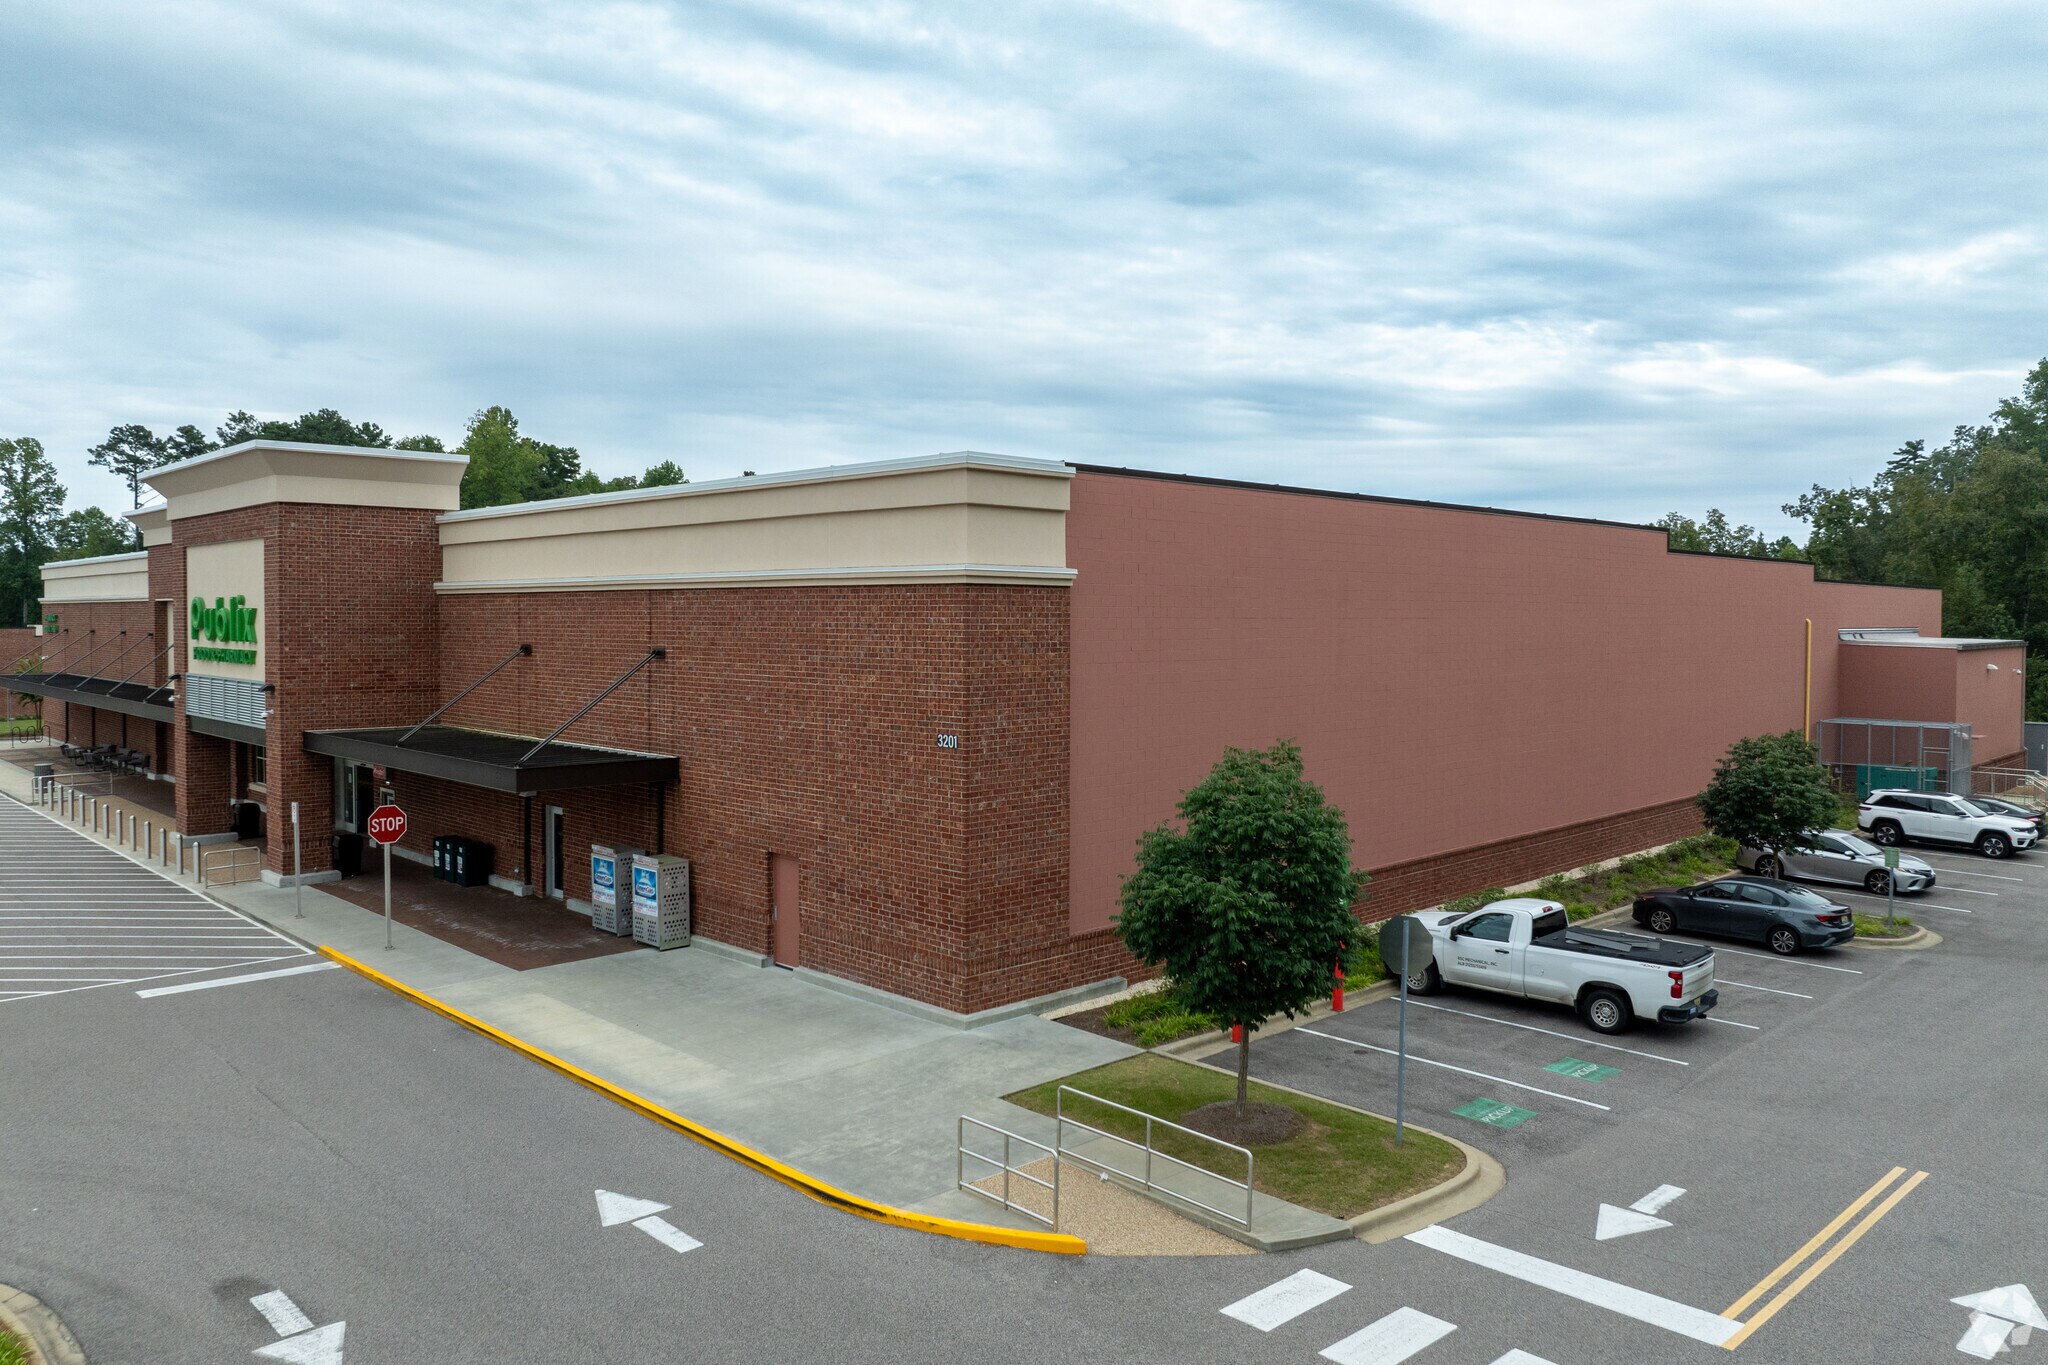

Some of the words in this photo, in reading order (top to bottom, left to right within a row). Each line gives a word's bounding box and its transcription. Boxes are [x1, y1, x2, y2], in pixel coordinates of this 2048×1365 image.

[191, 595, 257, 643] Publix
[938, 734, 957, 748] 3201
[371, 817, 404, 832] STOP
[1572, 1064, 1599, 1078] PICKUP
[1481, 1106, 1514, 1123] PICKUP
